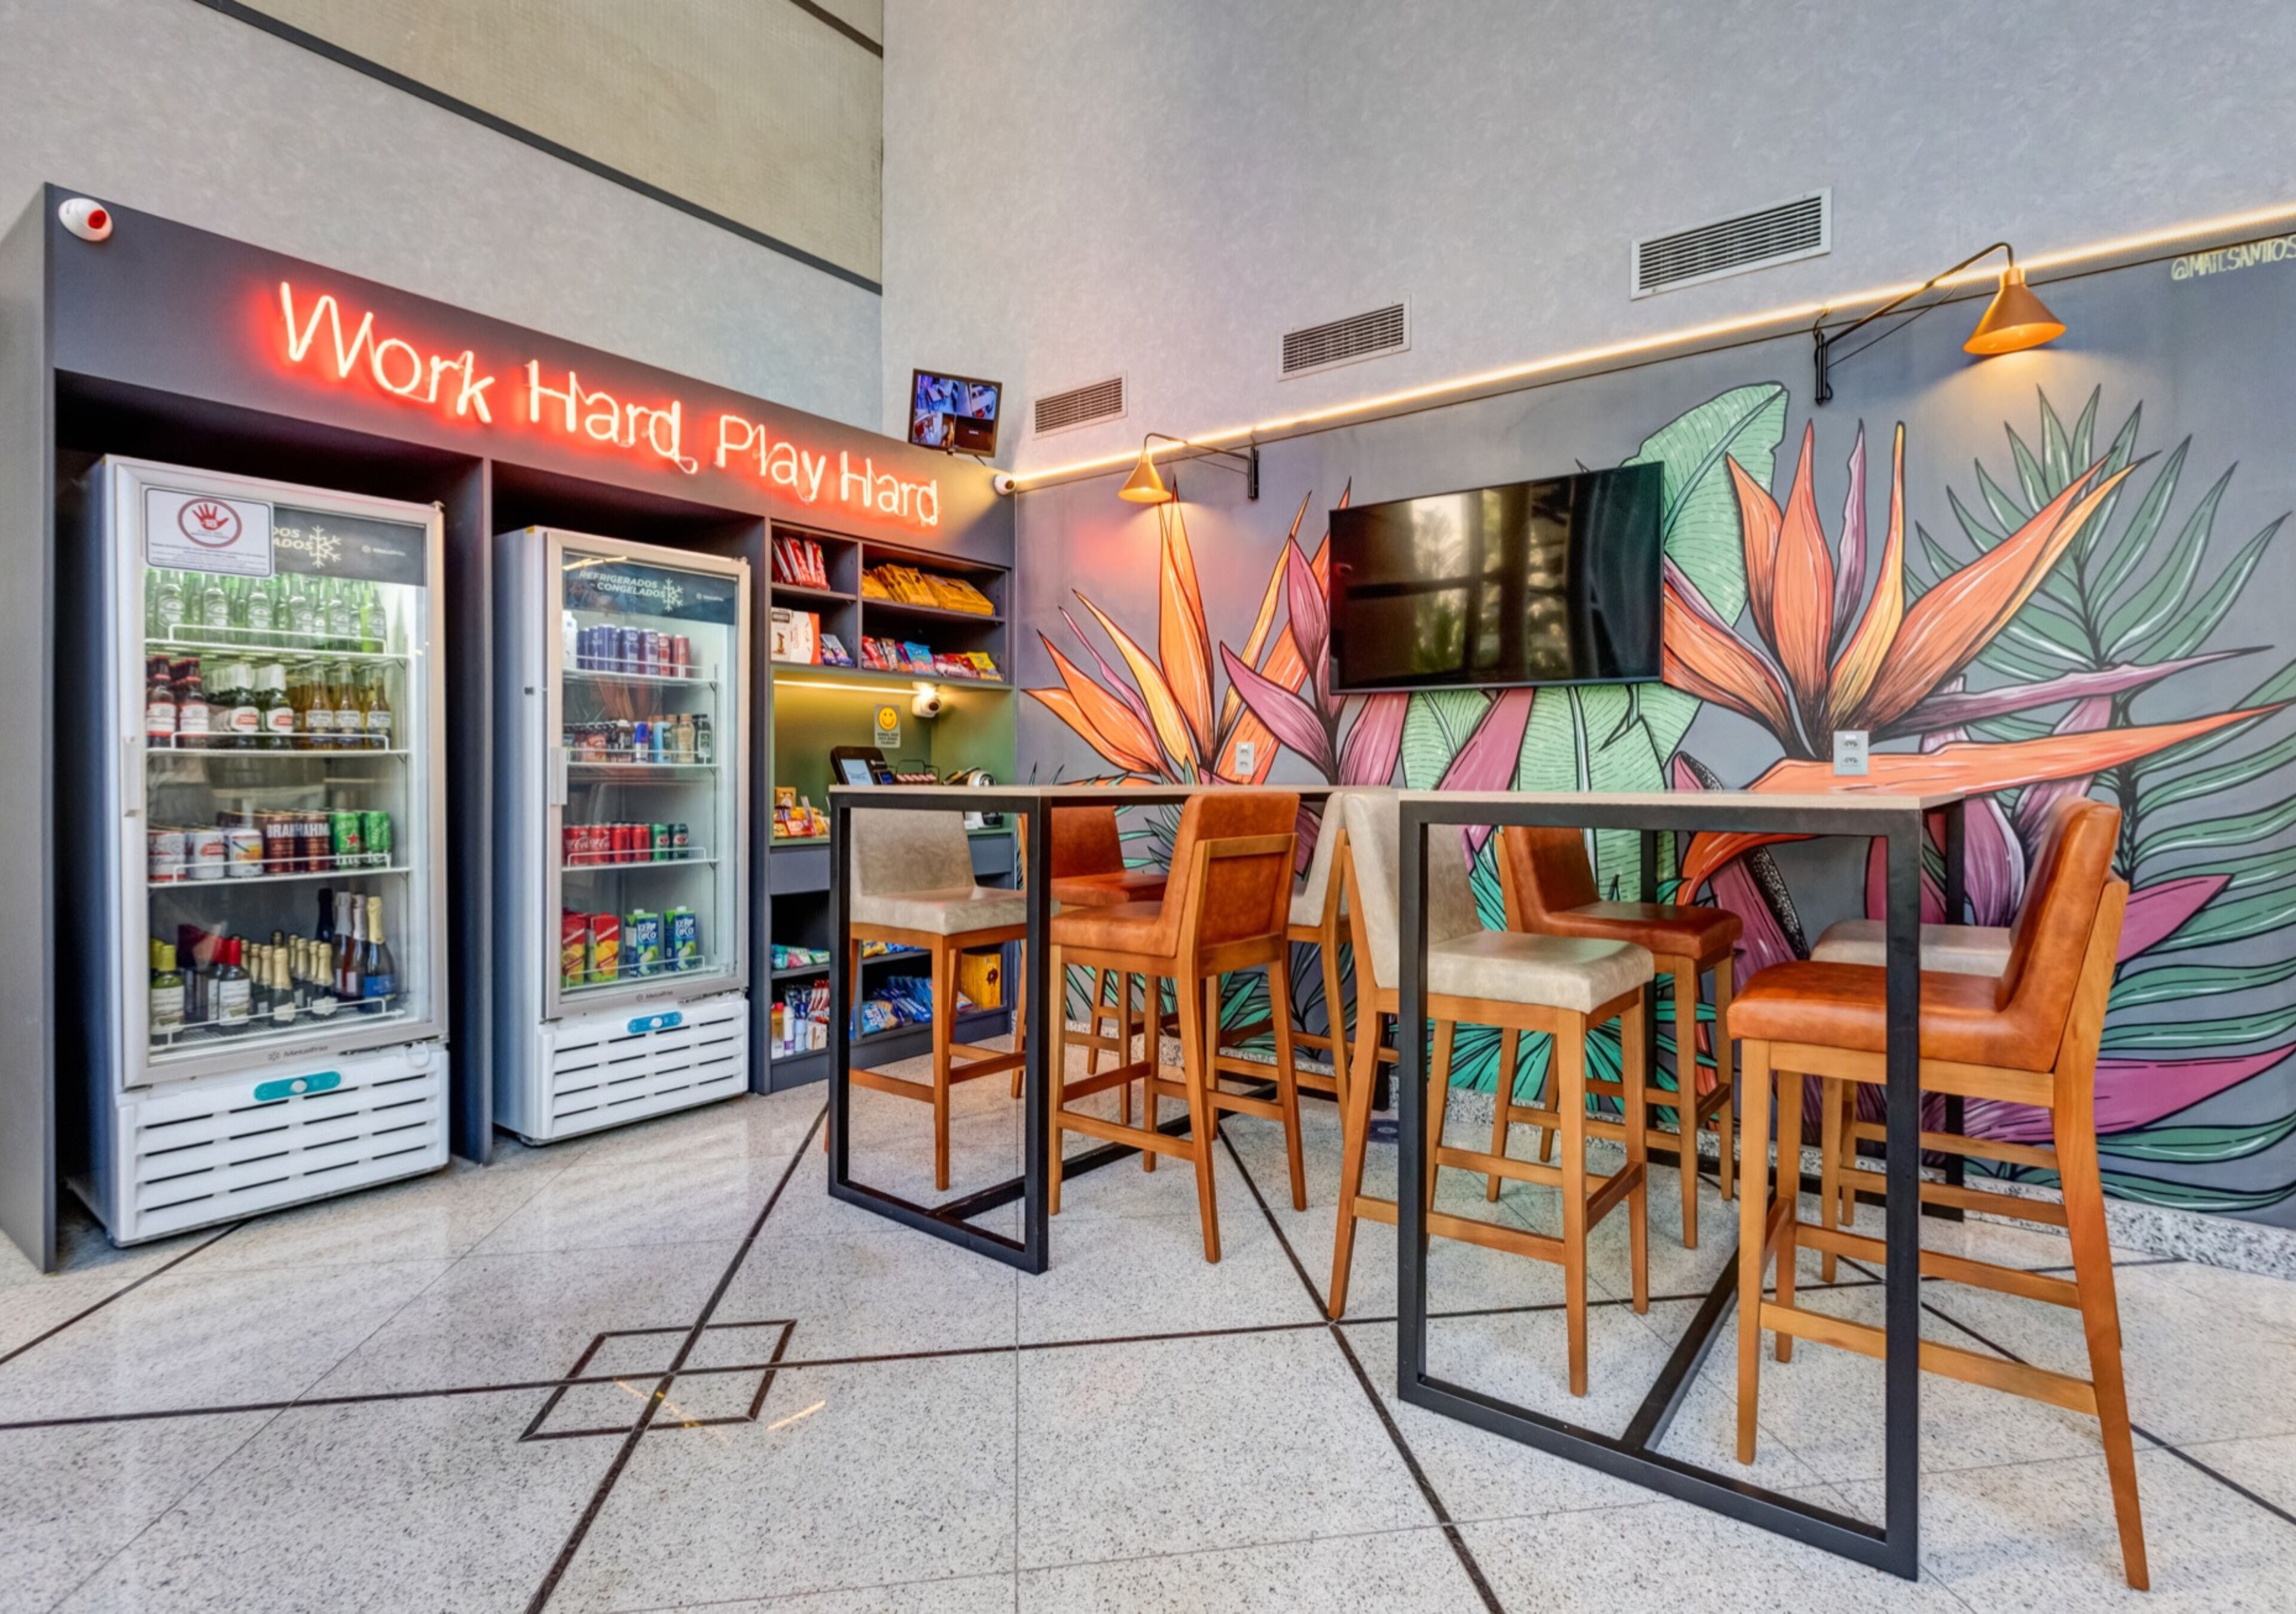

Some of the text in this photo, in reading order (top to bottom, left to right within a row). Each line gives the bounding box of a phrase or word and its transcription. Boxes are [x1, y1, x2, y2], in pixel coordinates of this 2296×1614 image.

[279, 281, 940, 526] Work Hard Play Hard
[579, 570, 658, 589] REFRIGERADOS
[597, 582, 666, 599] CONGELADOS
